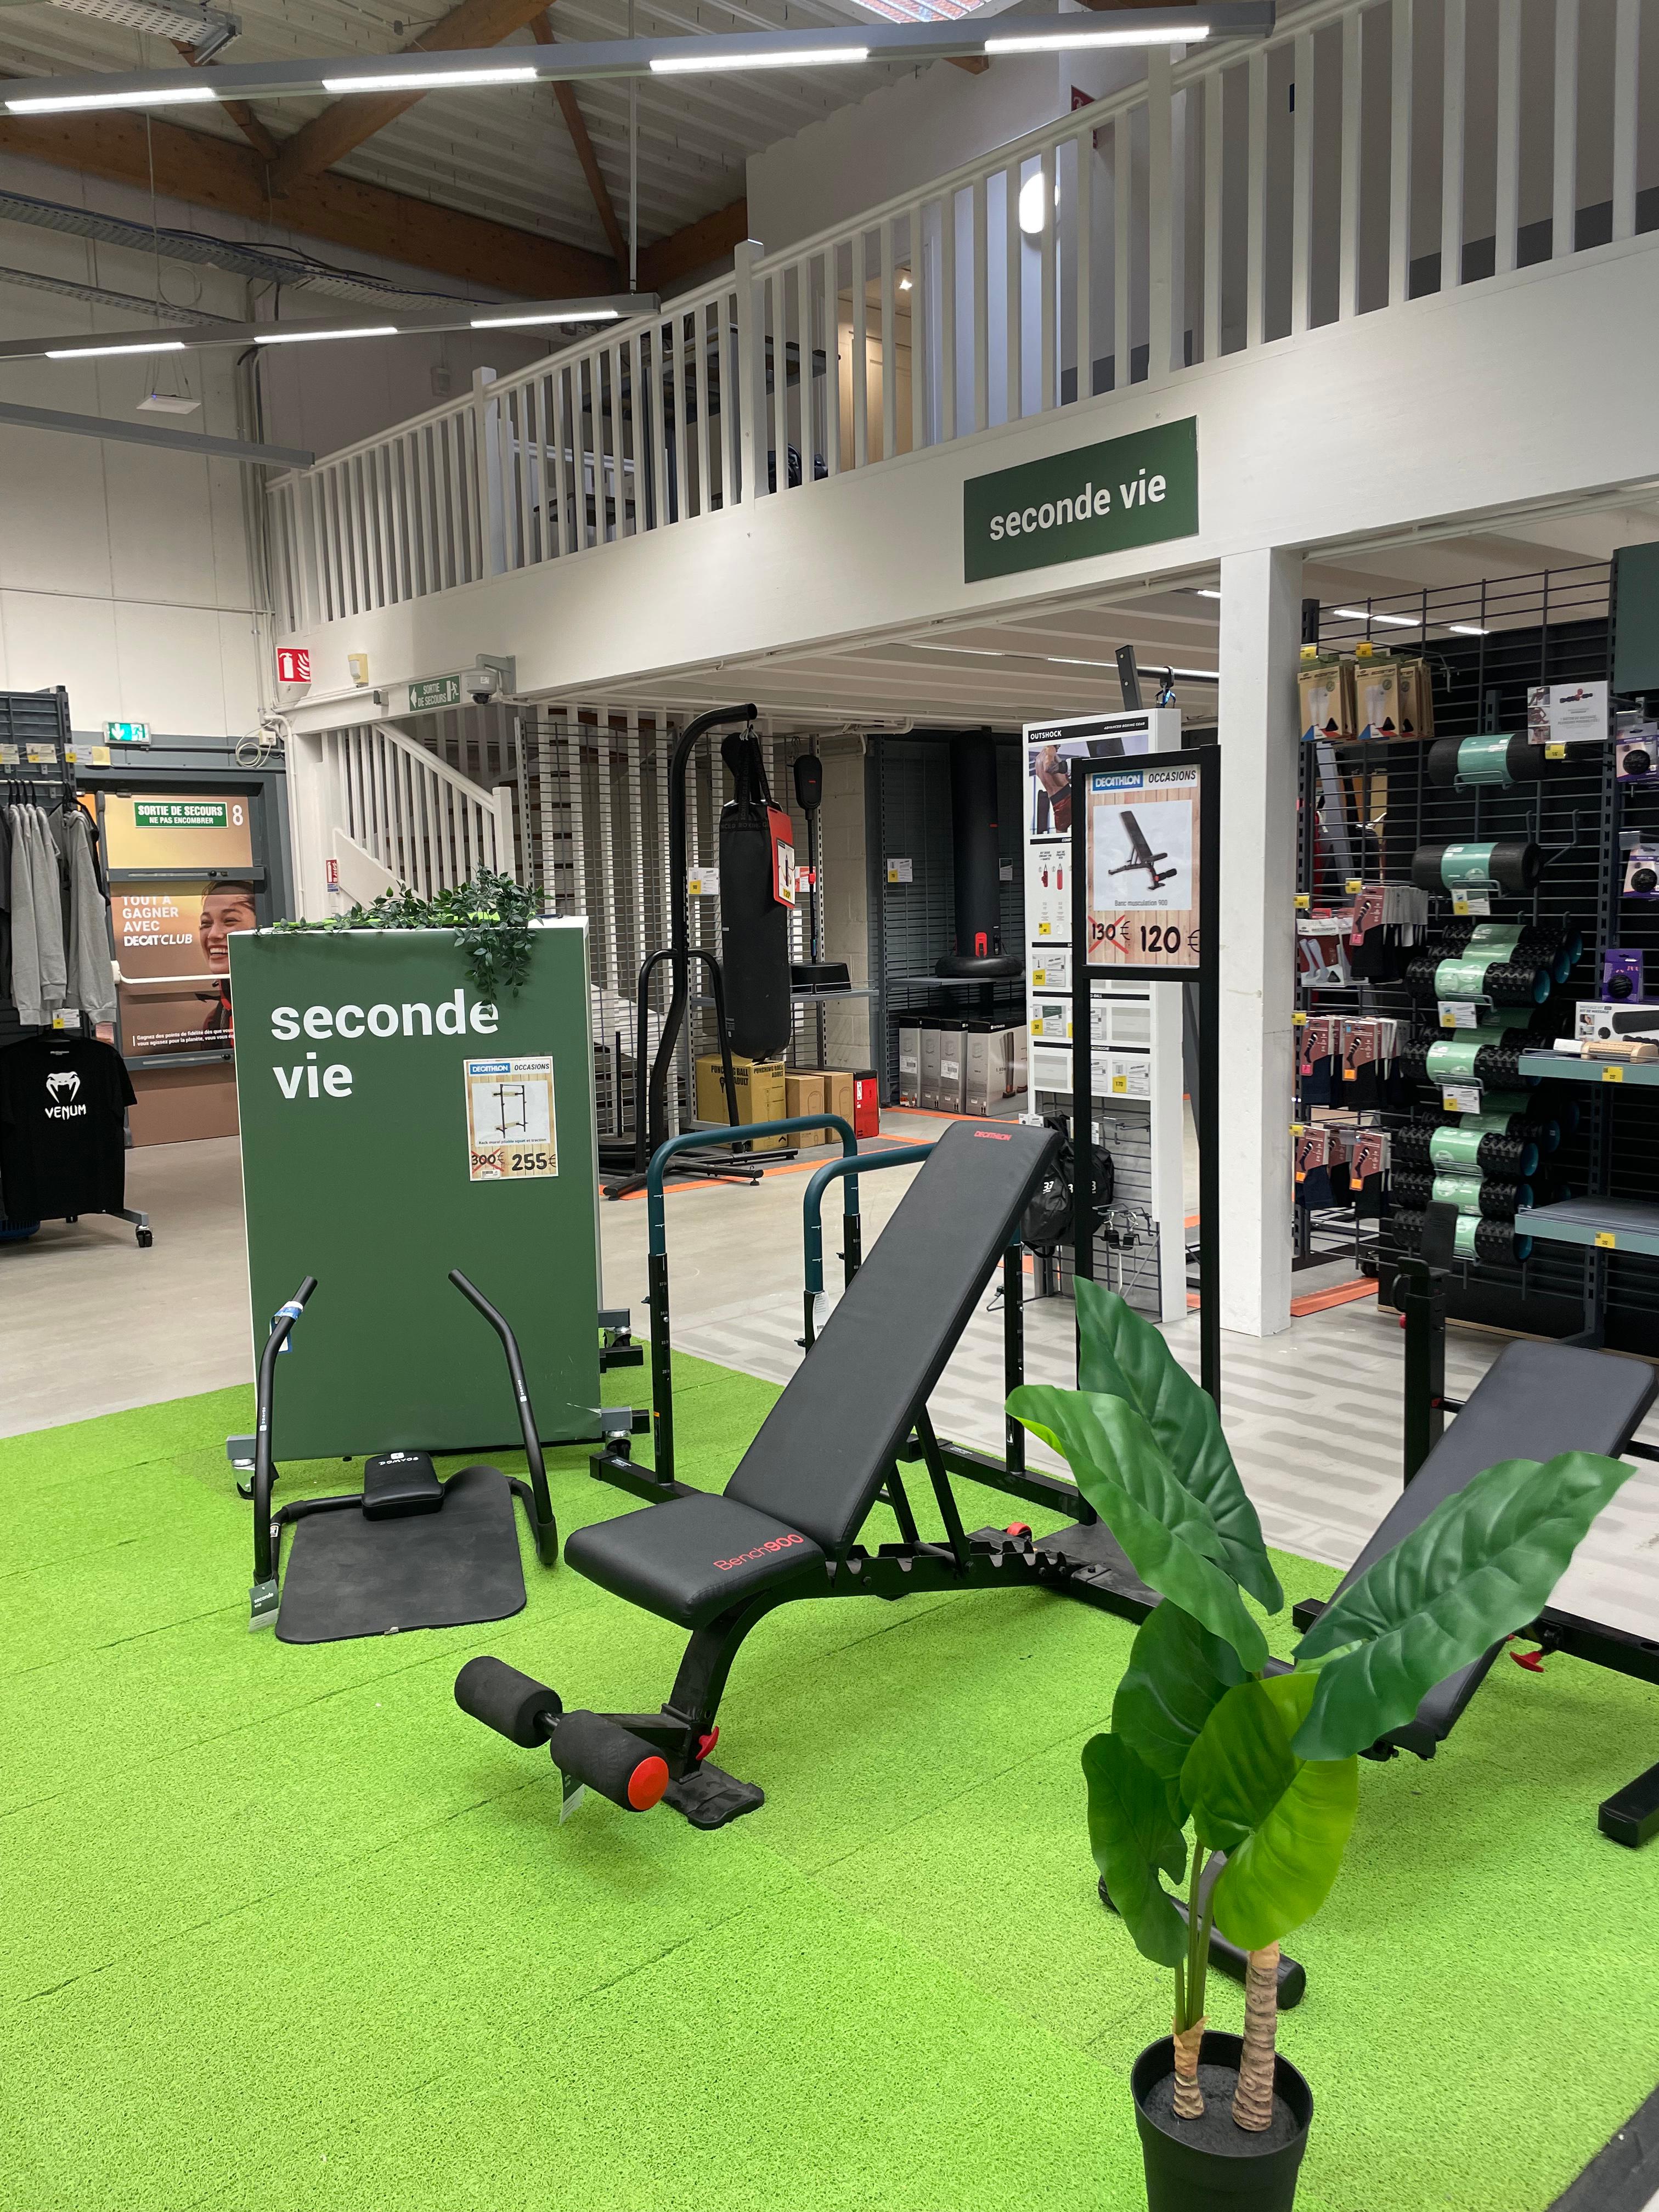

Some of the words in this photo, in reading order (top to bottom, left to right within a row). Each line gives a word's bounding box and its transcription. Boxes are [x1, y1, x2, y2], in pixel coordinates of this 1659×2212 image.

[990, 482, 1111, 540] seconde
[1120, 468, 1166, 509] vie
[423, 683, 440, 695] SORTIE
[418, 697, 425, 707] DE
[425, 693, 447, 706] SECOURS
[1030, 730, 1062, 740] OUTSHOCK
[1096, 774, 1141, 788] DECATHLON
[1148, 770, 1196, 783] OCCASIONS
[138, 805, 168, 816] SORTIE
[171, 805, 182, 816] DE
[184, 805, 223, 816] SECOURS
[232, 805, 244, 826] 8
[122, 896, 157, 906] TOUT
[162, 896, 172, 905] A
[122, 907, 179, 919] GAGNER
[123, 921, 160, 933] AVEC
[123, 934, 193, 947] DECAT'CLUB
[270, 989, 499, 1041] seconde
[472, 1064, 509, 1073] DECATHLON
[737, 1068, 748, 1076] BALL
[754, 1065, 774, 1074] PUNCHING
[272, 1052, 353, 1099] vie
[733, 1076, 748, 1086] ADULT
[45, 1104, 87, 1120] VENUM
[974, 1130, 1012, 1141] DECATHLON
[713, 1534, 804, 1571] Bench900
[253, 1592, 274, 1604] seconde
